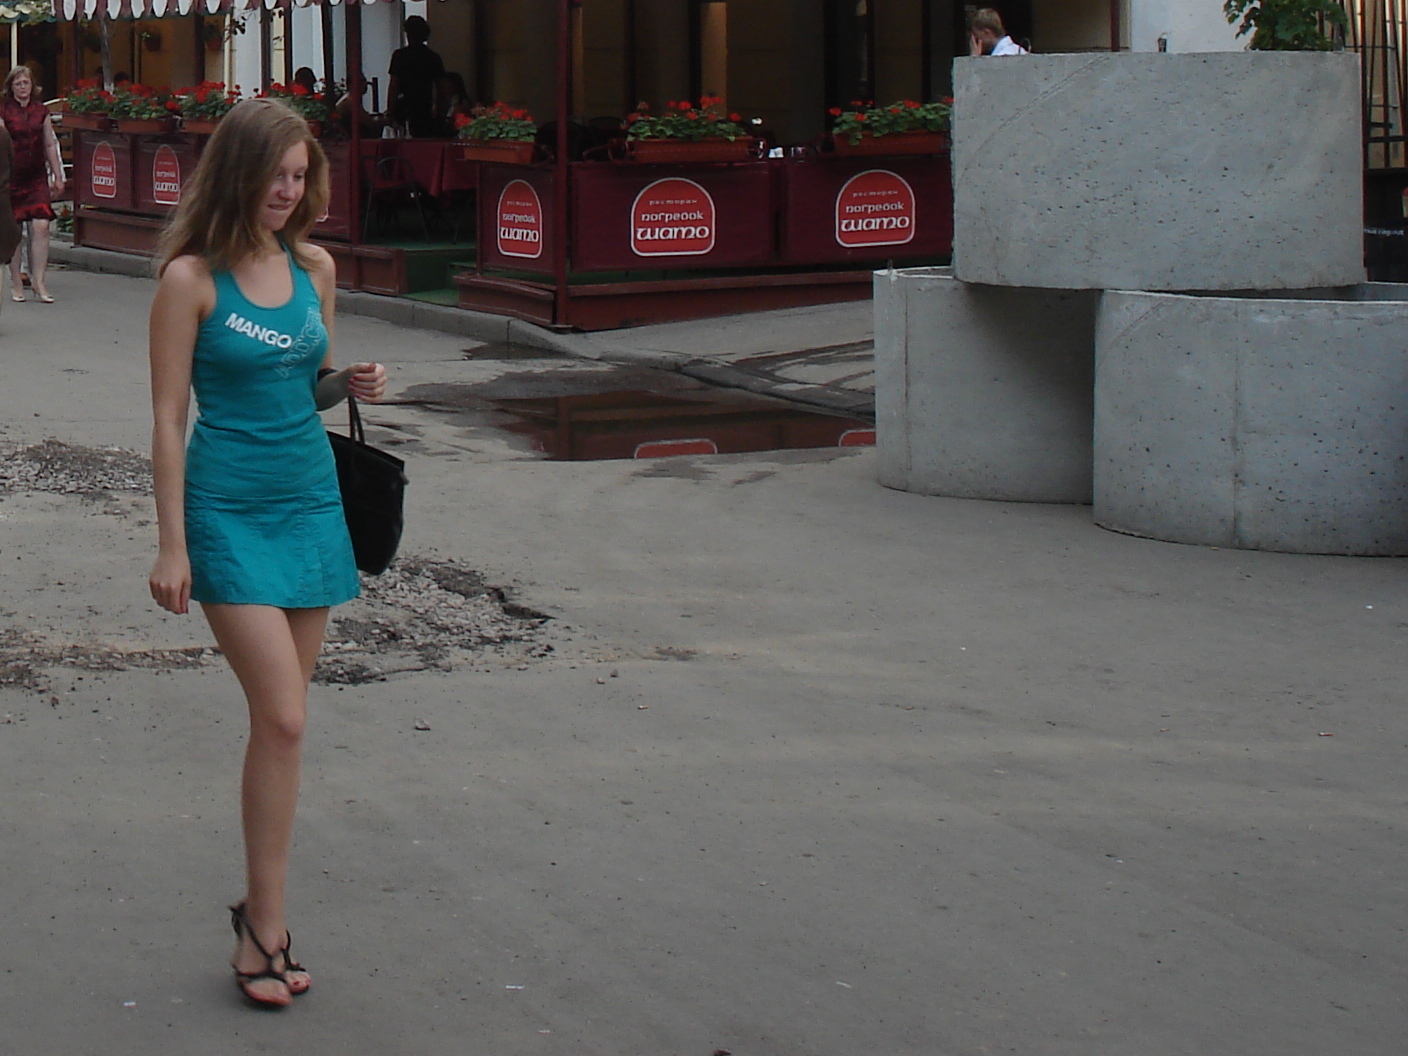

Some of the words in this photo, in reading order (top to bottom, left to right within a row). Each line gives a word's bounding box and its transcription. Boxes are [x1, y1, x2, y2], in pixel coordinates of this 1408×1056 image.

[845, 201, 904, 214] погребок
[641, 210, 704, 223] погребок
[224, 312, 292, 349] MANGO
